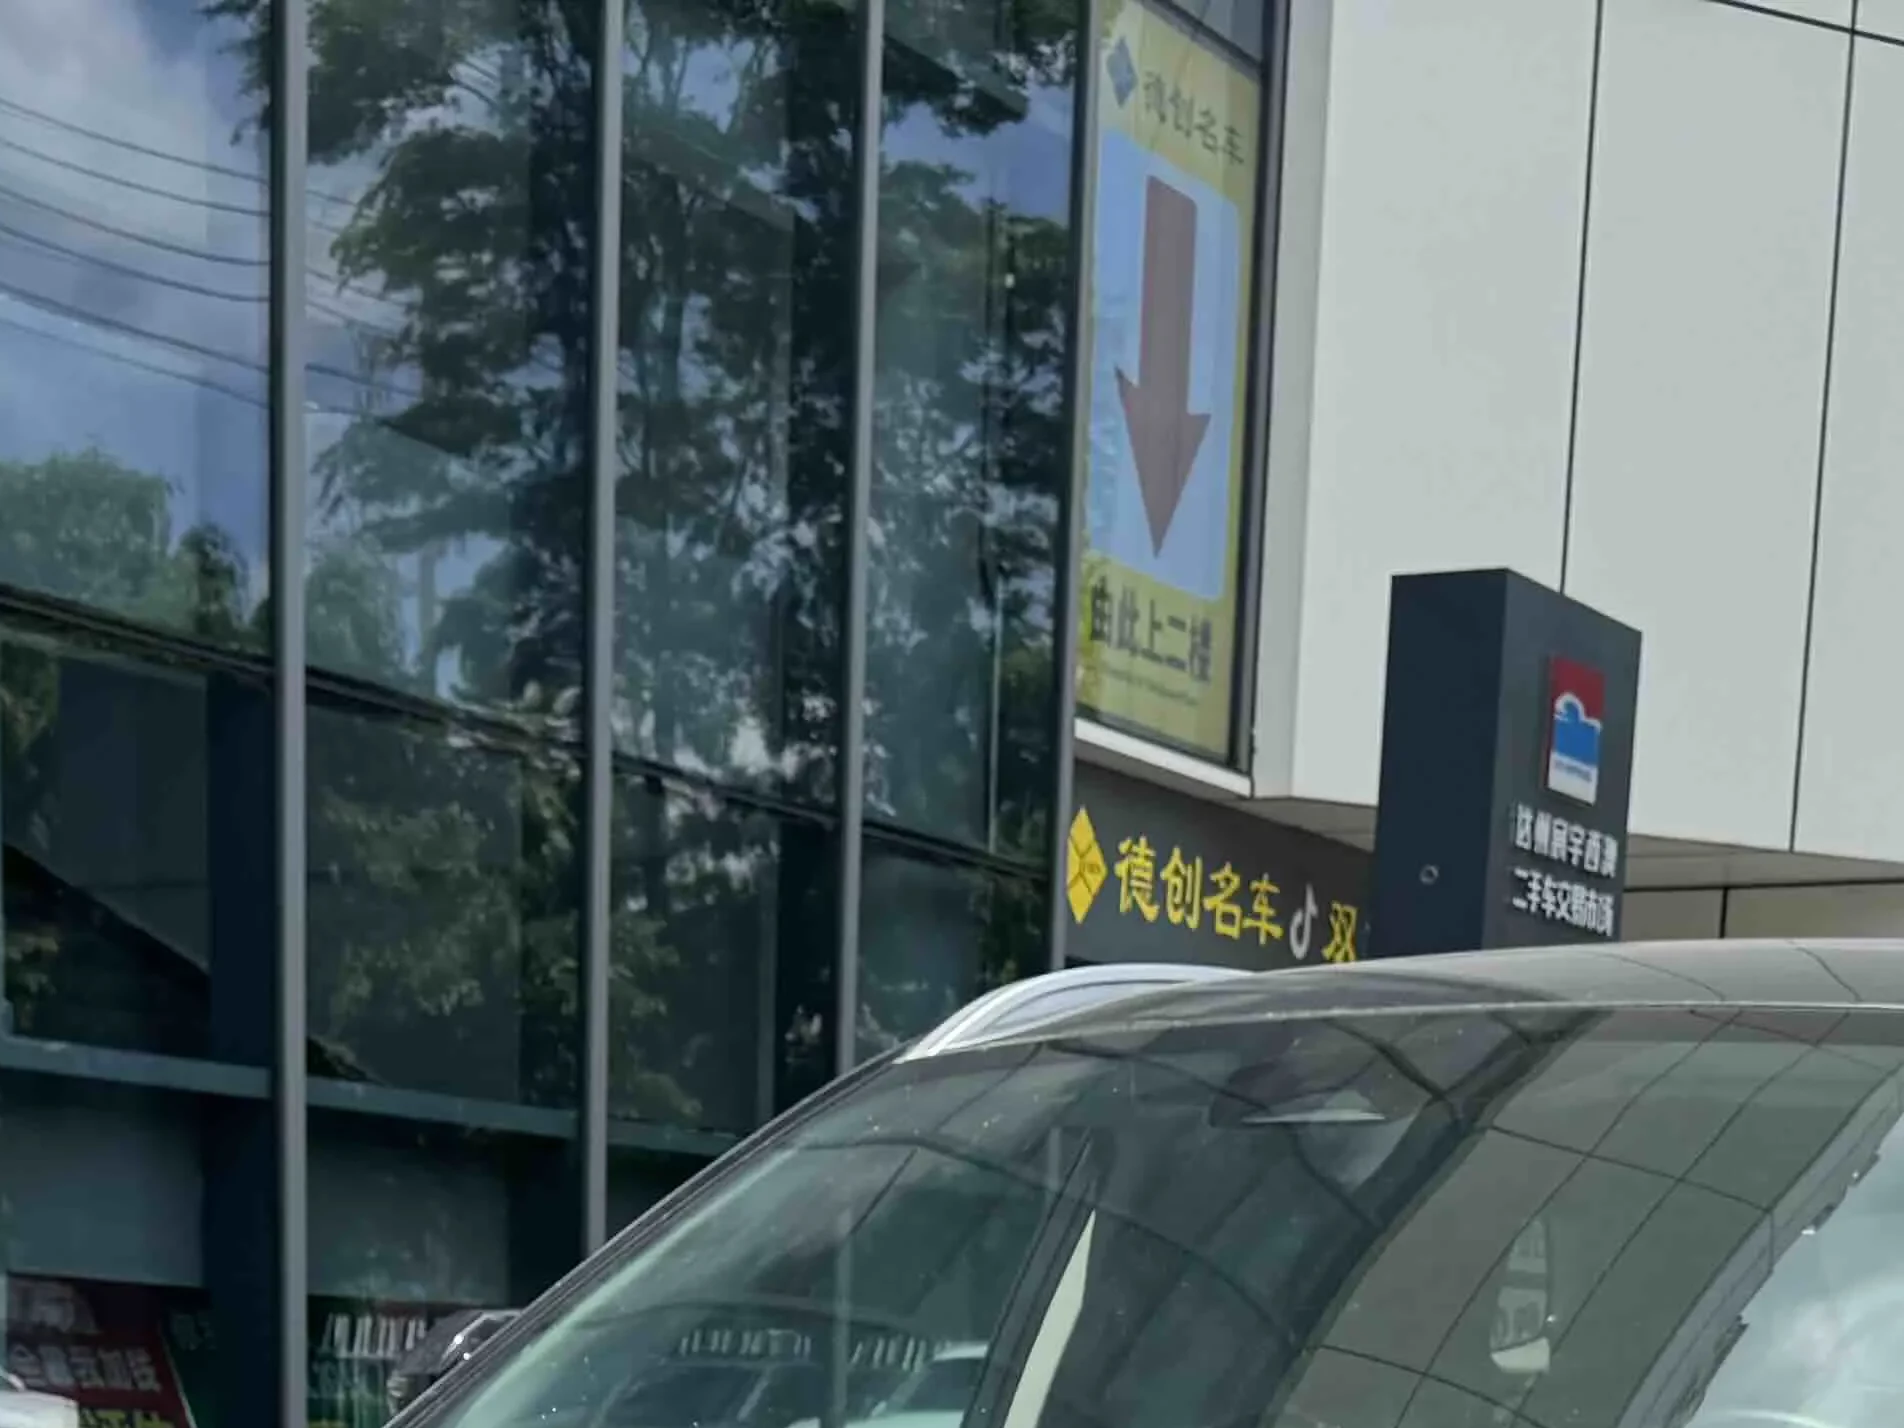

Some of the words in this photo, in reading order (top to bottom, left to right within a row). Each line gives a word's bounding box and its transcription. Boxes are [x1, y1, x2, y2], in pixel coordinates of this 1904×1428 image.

[1114, 832, 1284, 946] 德创名车
[1511, 866, 1615, 938] 二手车交易市场
